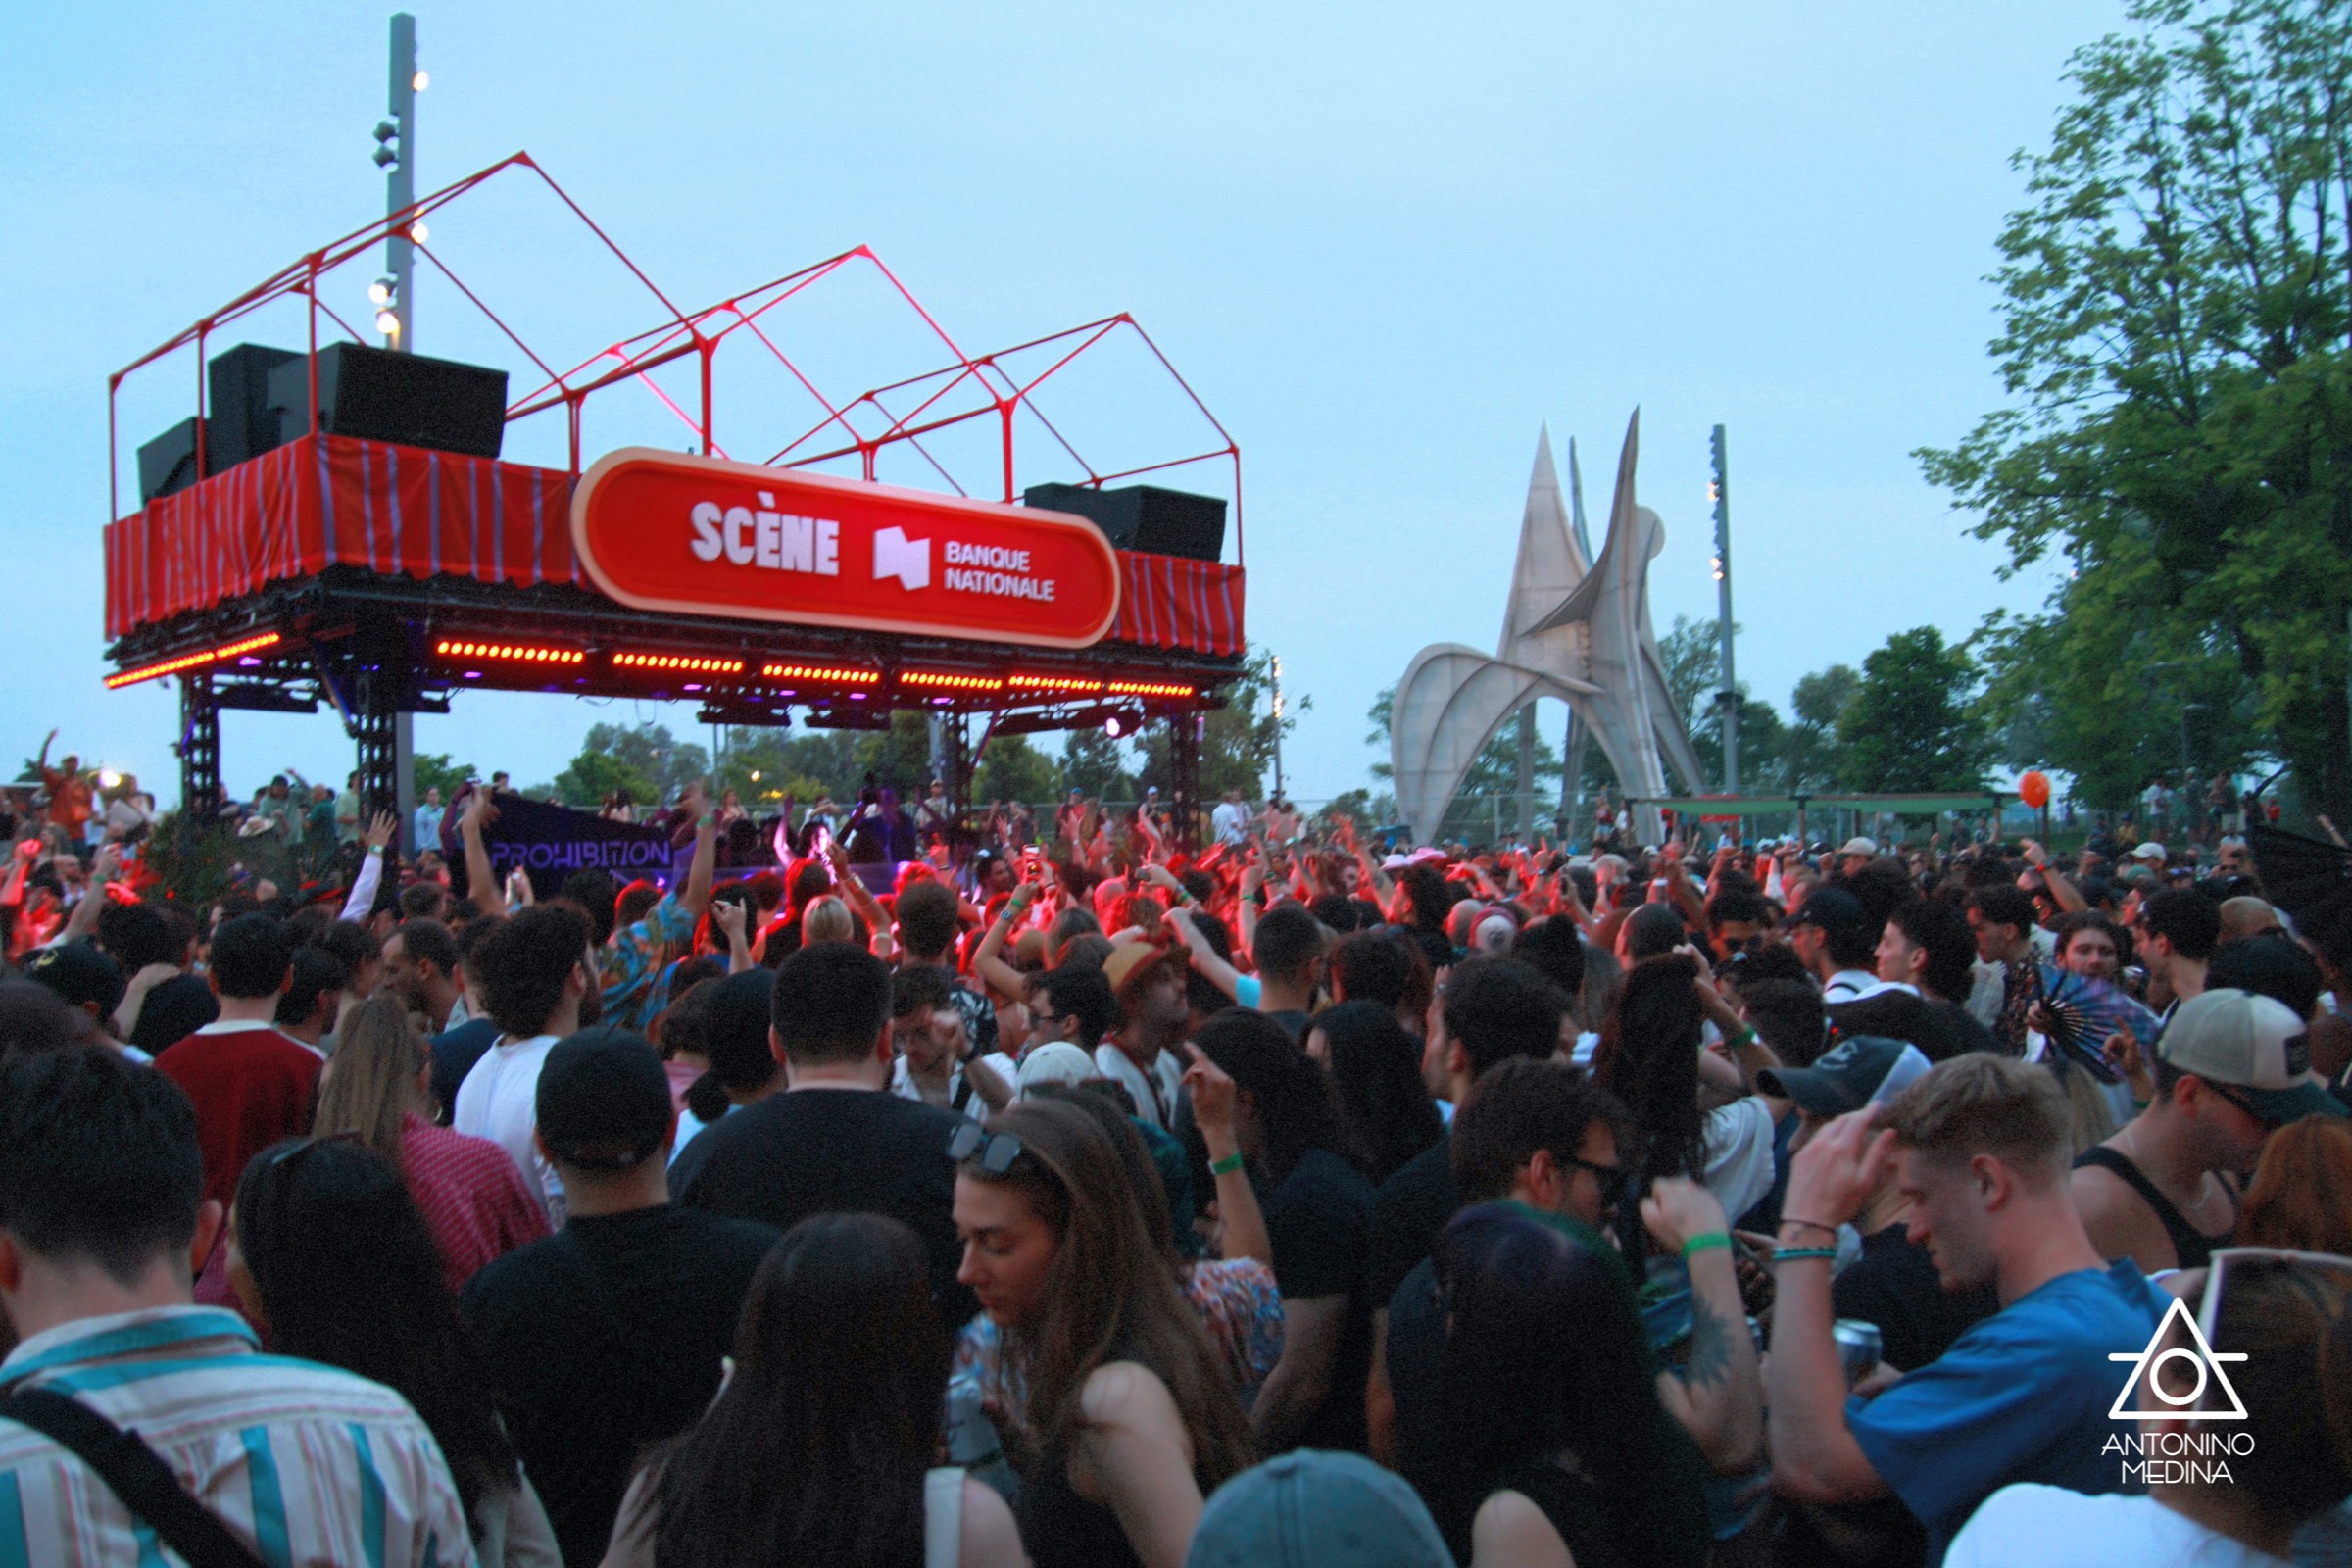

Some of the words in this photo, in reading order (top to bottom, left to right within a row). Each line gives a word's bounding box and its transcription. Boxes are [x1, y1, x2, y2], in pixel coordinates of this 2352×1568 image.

[690, 490, 840, 576] SCÈNE
[944, 540, 1031, 572] BANQUE
[944, 567, 1055, 602] NATIONALE
[492, 840, 670, 869] PROHIBITION
